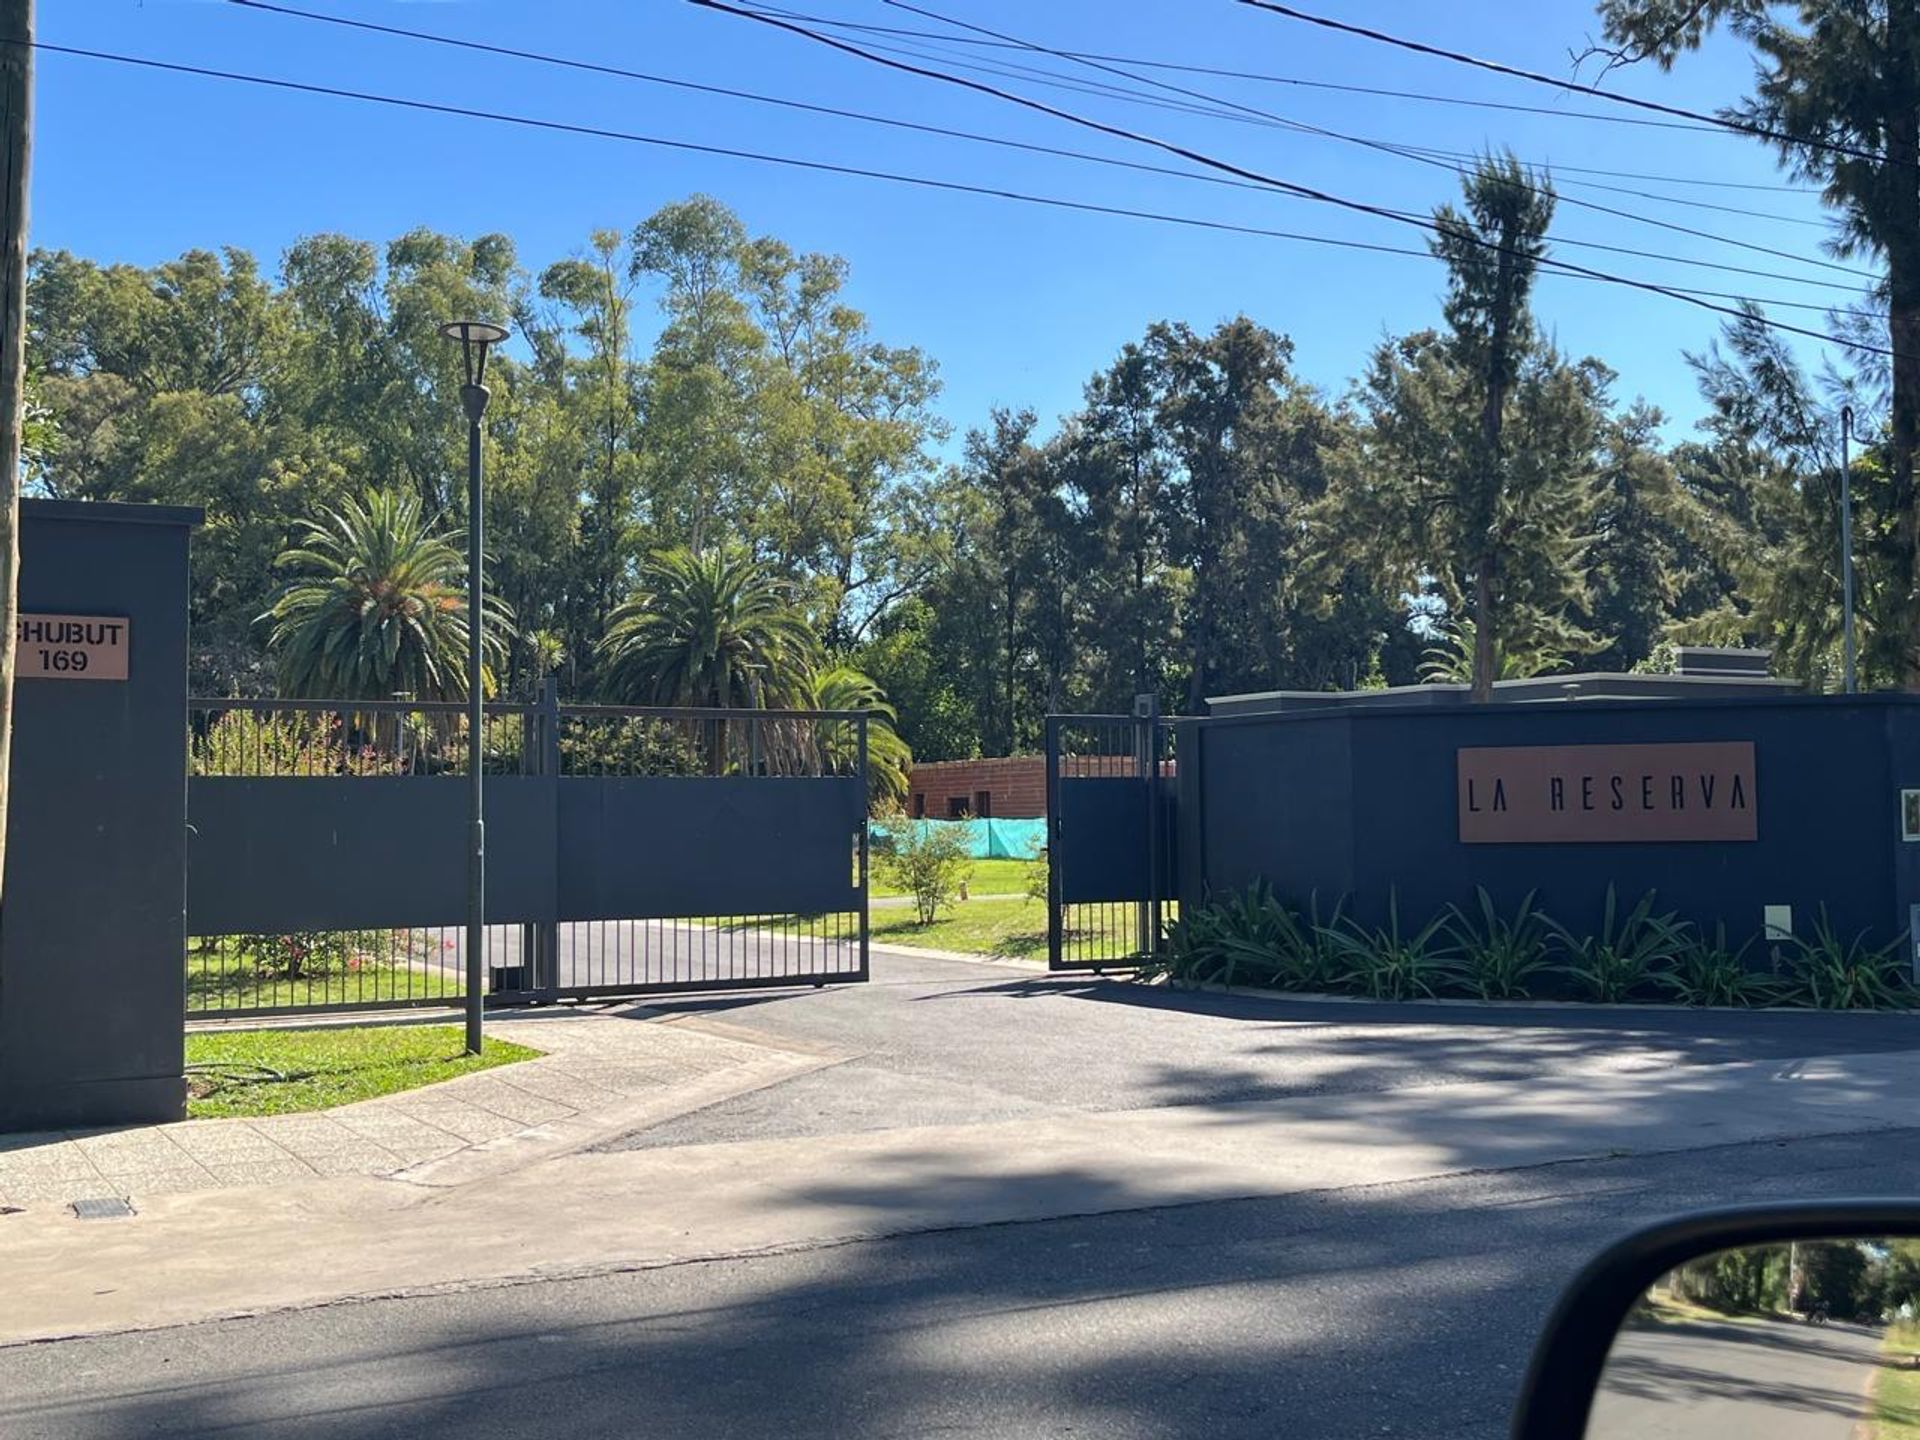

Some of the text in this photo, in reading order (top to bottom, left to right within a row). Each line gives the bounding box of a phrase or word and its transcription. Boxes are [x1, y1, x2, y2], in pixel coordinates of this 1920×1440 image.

[16, 621, 124, 646] HUBUT
[39, 650, 88, 672] 169
[1468, 774, 1746, 812] LA RESERVA
